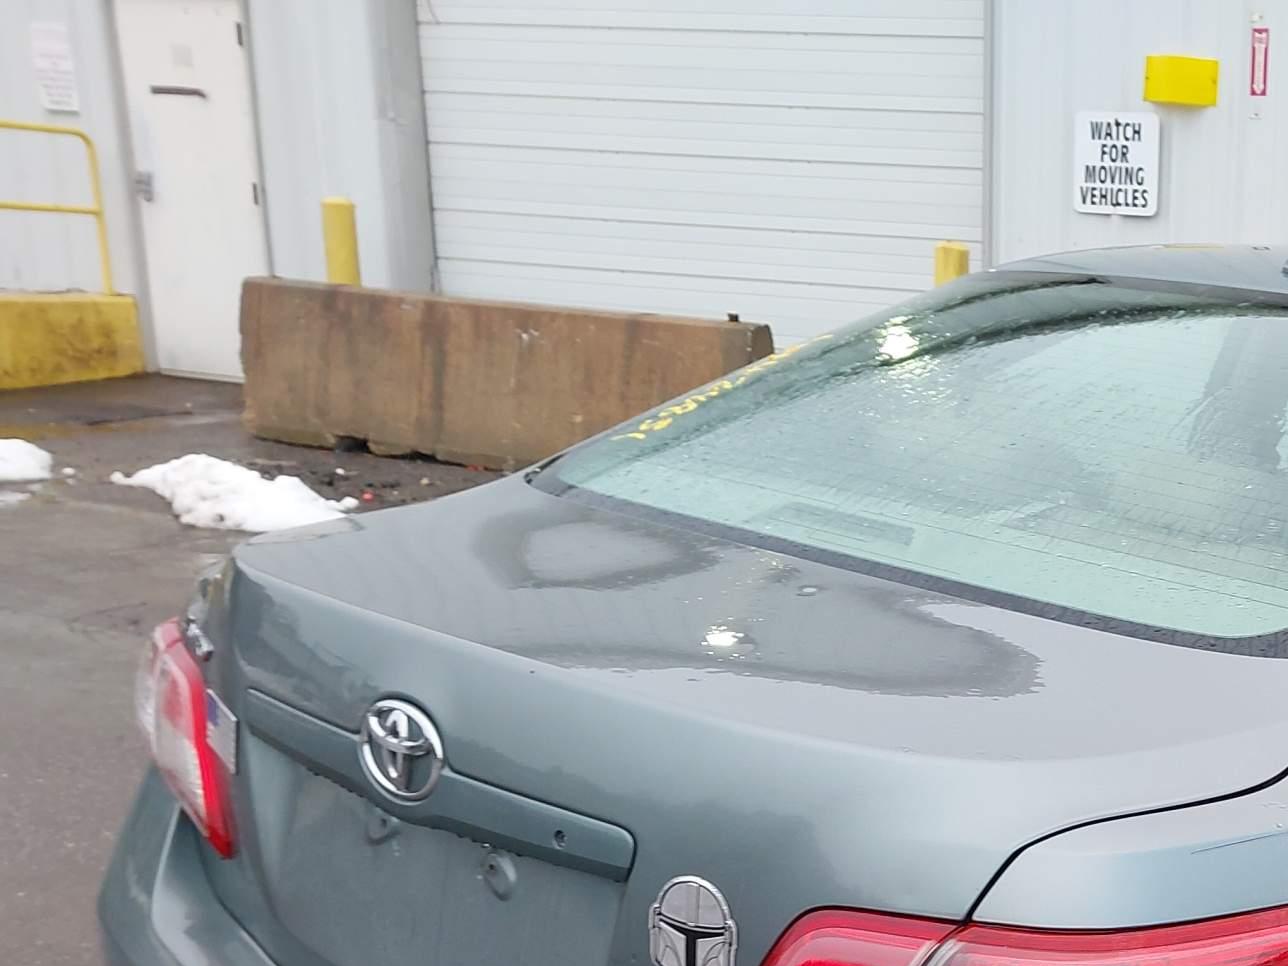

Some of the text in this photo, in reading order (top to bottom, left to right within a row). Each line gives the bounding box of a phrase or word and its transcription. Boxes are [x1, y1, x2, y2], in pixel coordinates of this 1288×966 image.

[1090, 119, 1142, 142] WATCH
[1100, 144, 1129, 164] FOR
[1084, 164, 1145, 186] MOVING
[1079, 186, 1149, 209] VEHICLES
